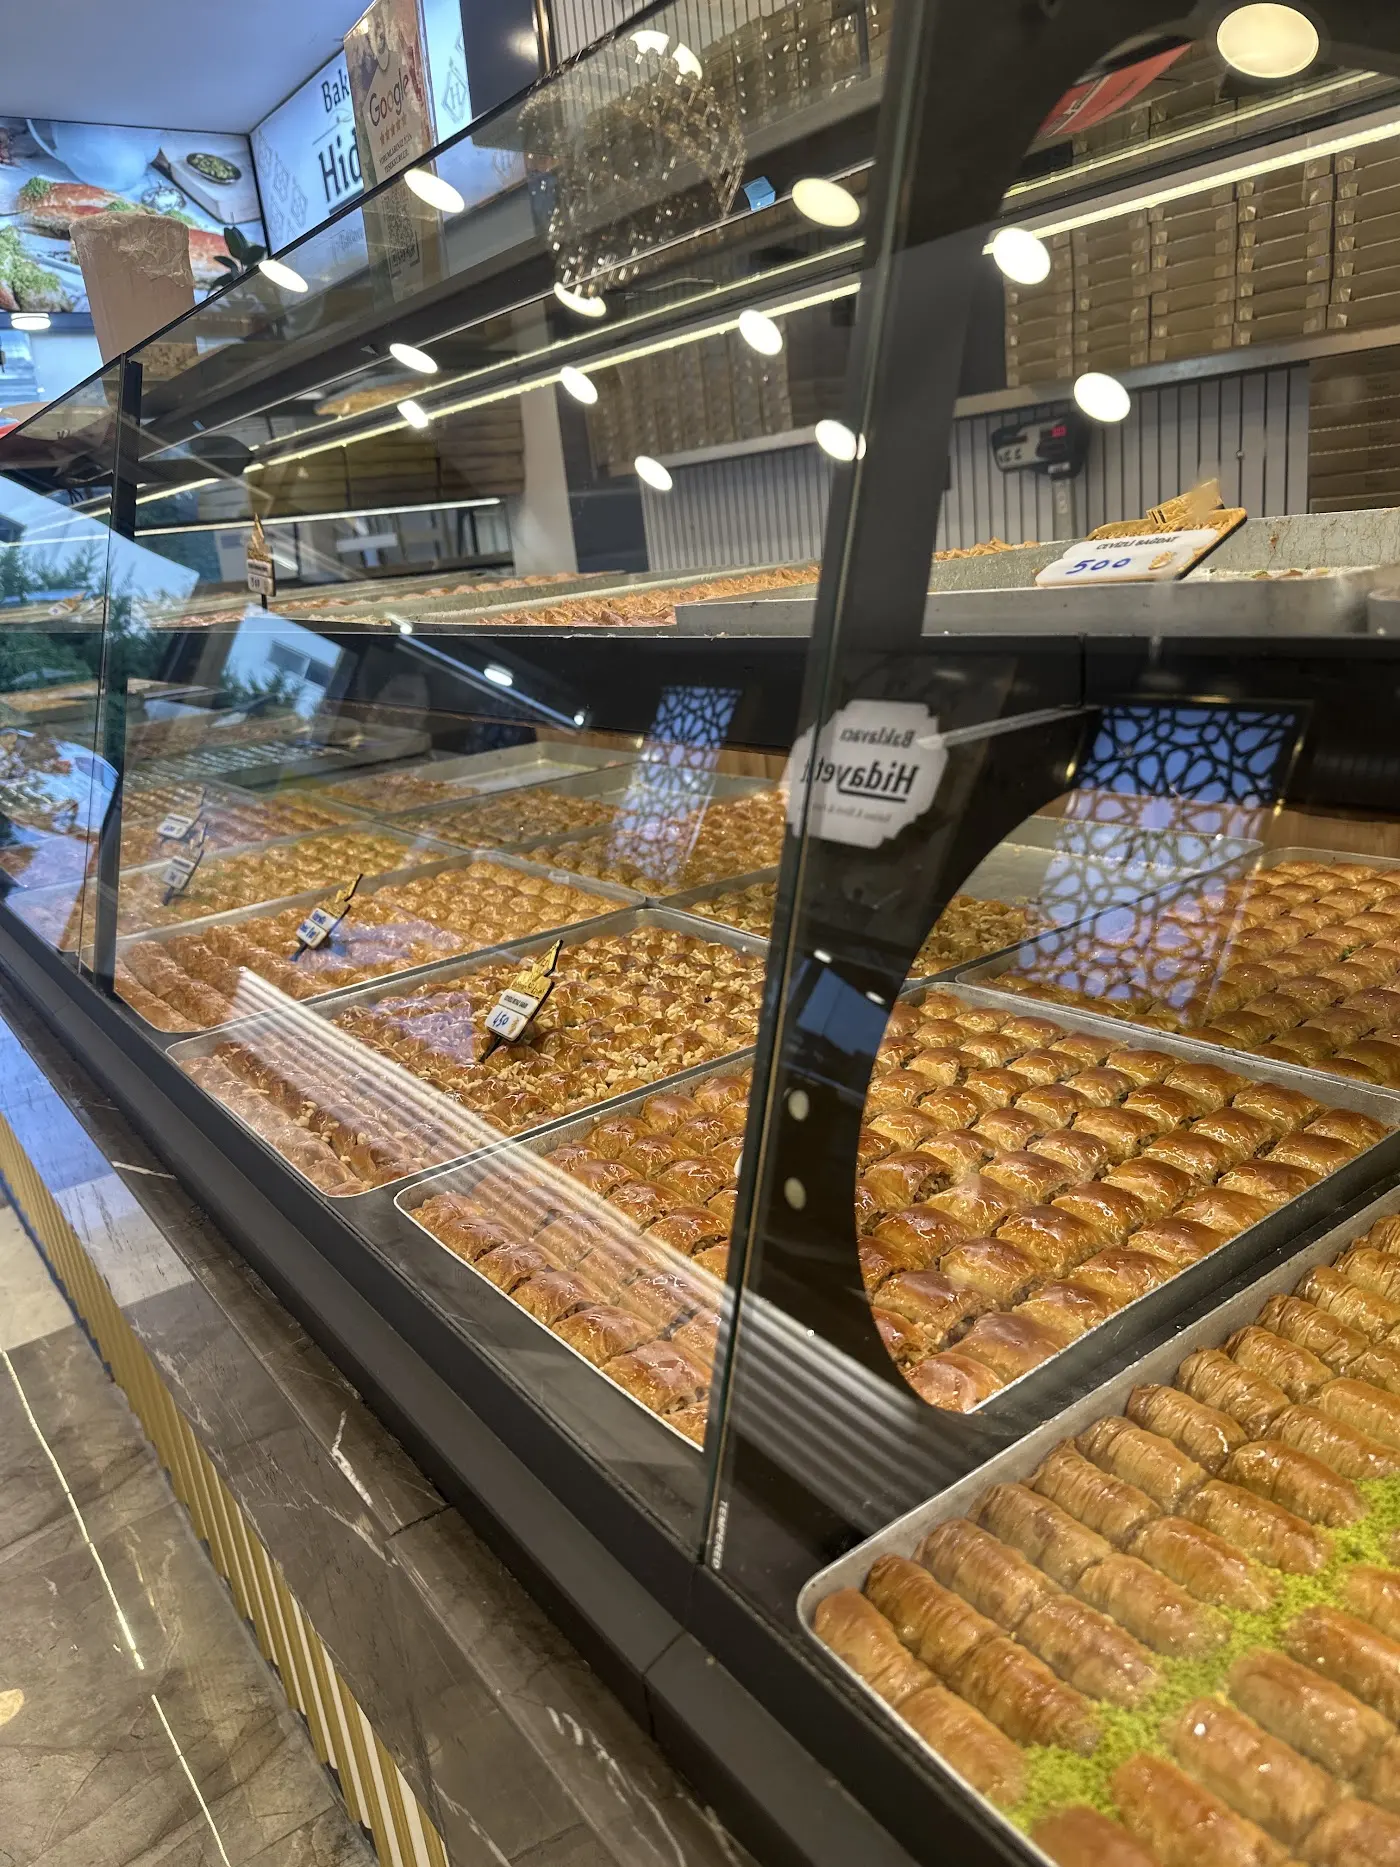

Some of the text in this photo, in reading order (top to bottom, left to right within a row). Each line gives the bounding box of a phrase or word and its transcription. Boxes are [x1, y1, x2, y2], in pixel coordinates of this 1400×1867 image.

[369, 67, 409, 127] Google
[1065, 557, 1132, 575] 500
[712, 1499, 728, 1569] TEMPERED
